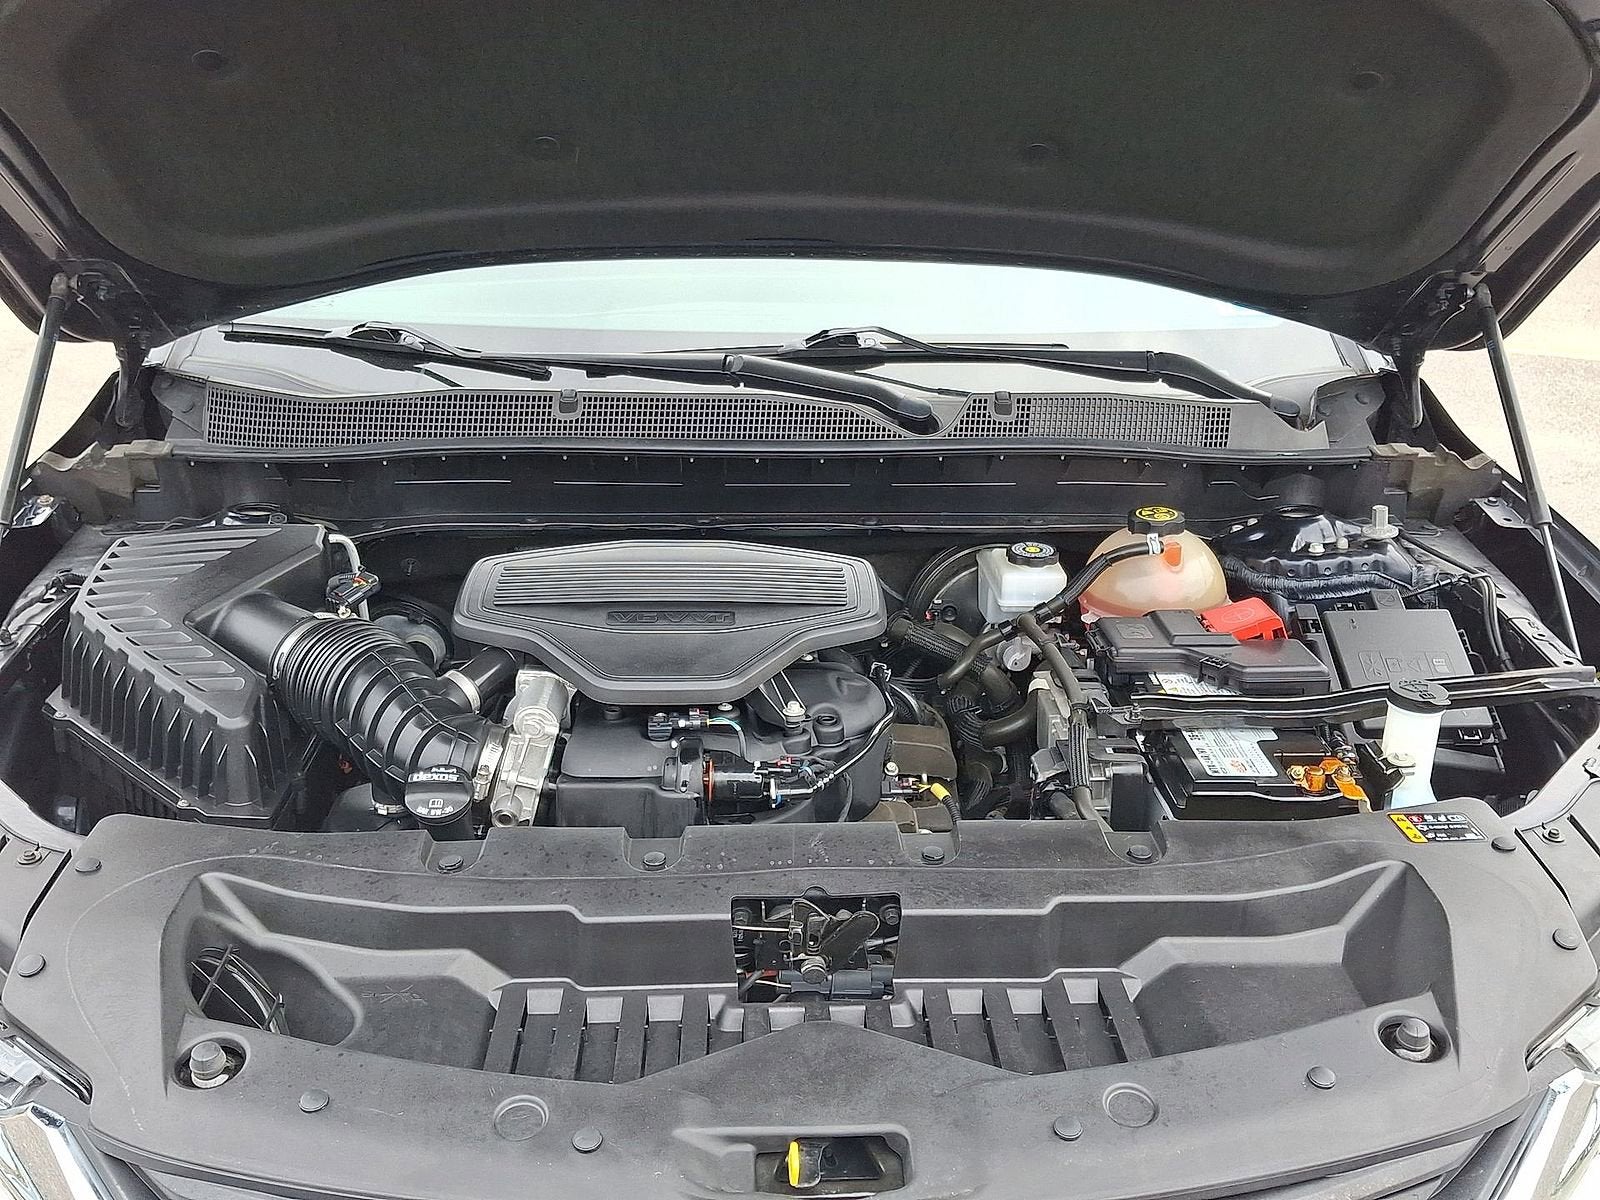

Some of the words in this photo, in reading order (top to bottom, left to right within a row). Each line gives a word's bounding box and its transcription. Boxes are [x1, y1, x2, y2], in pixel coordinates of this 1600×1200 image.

[612, 612, 659, 623] V6
[663, 612, 731, 623] VVT
[412, 771, 460, 781] dexos
